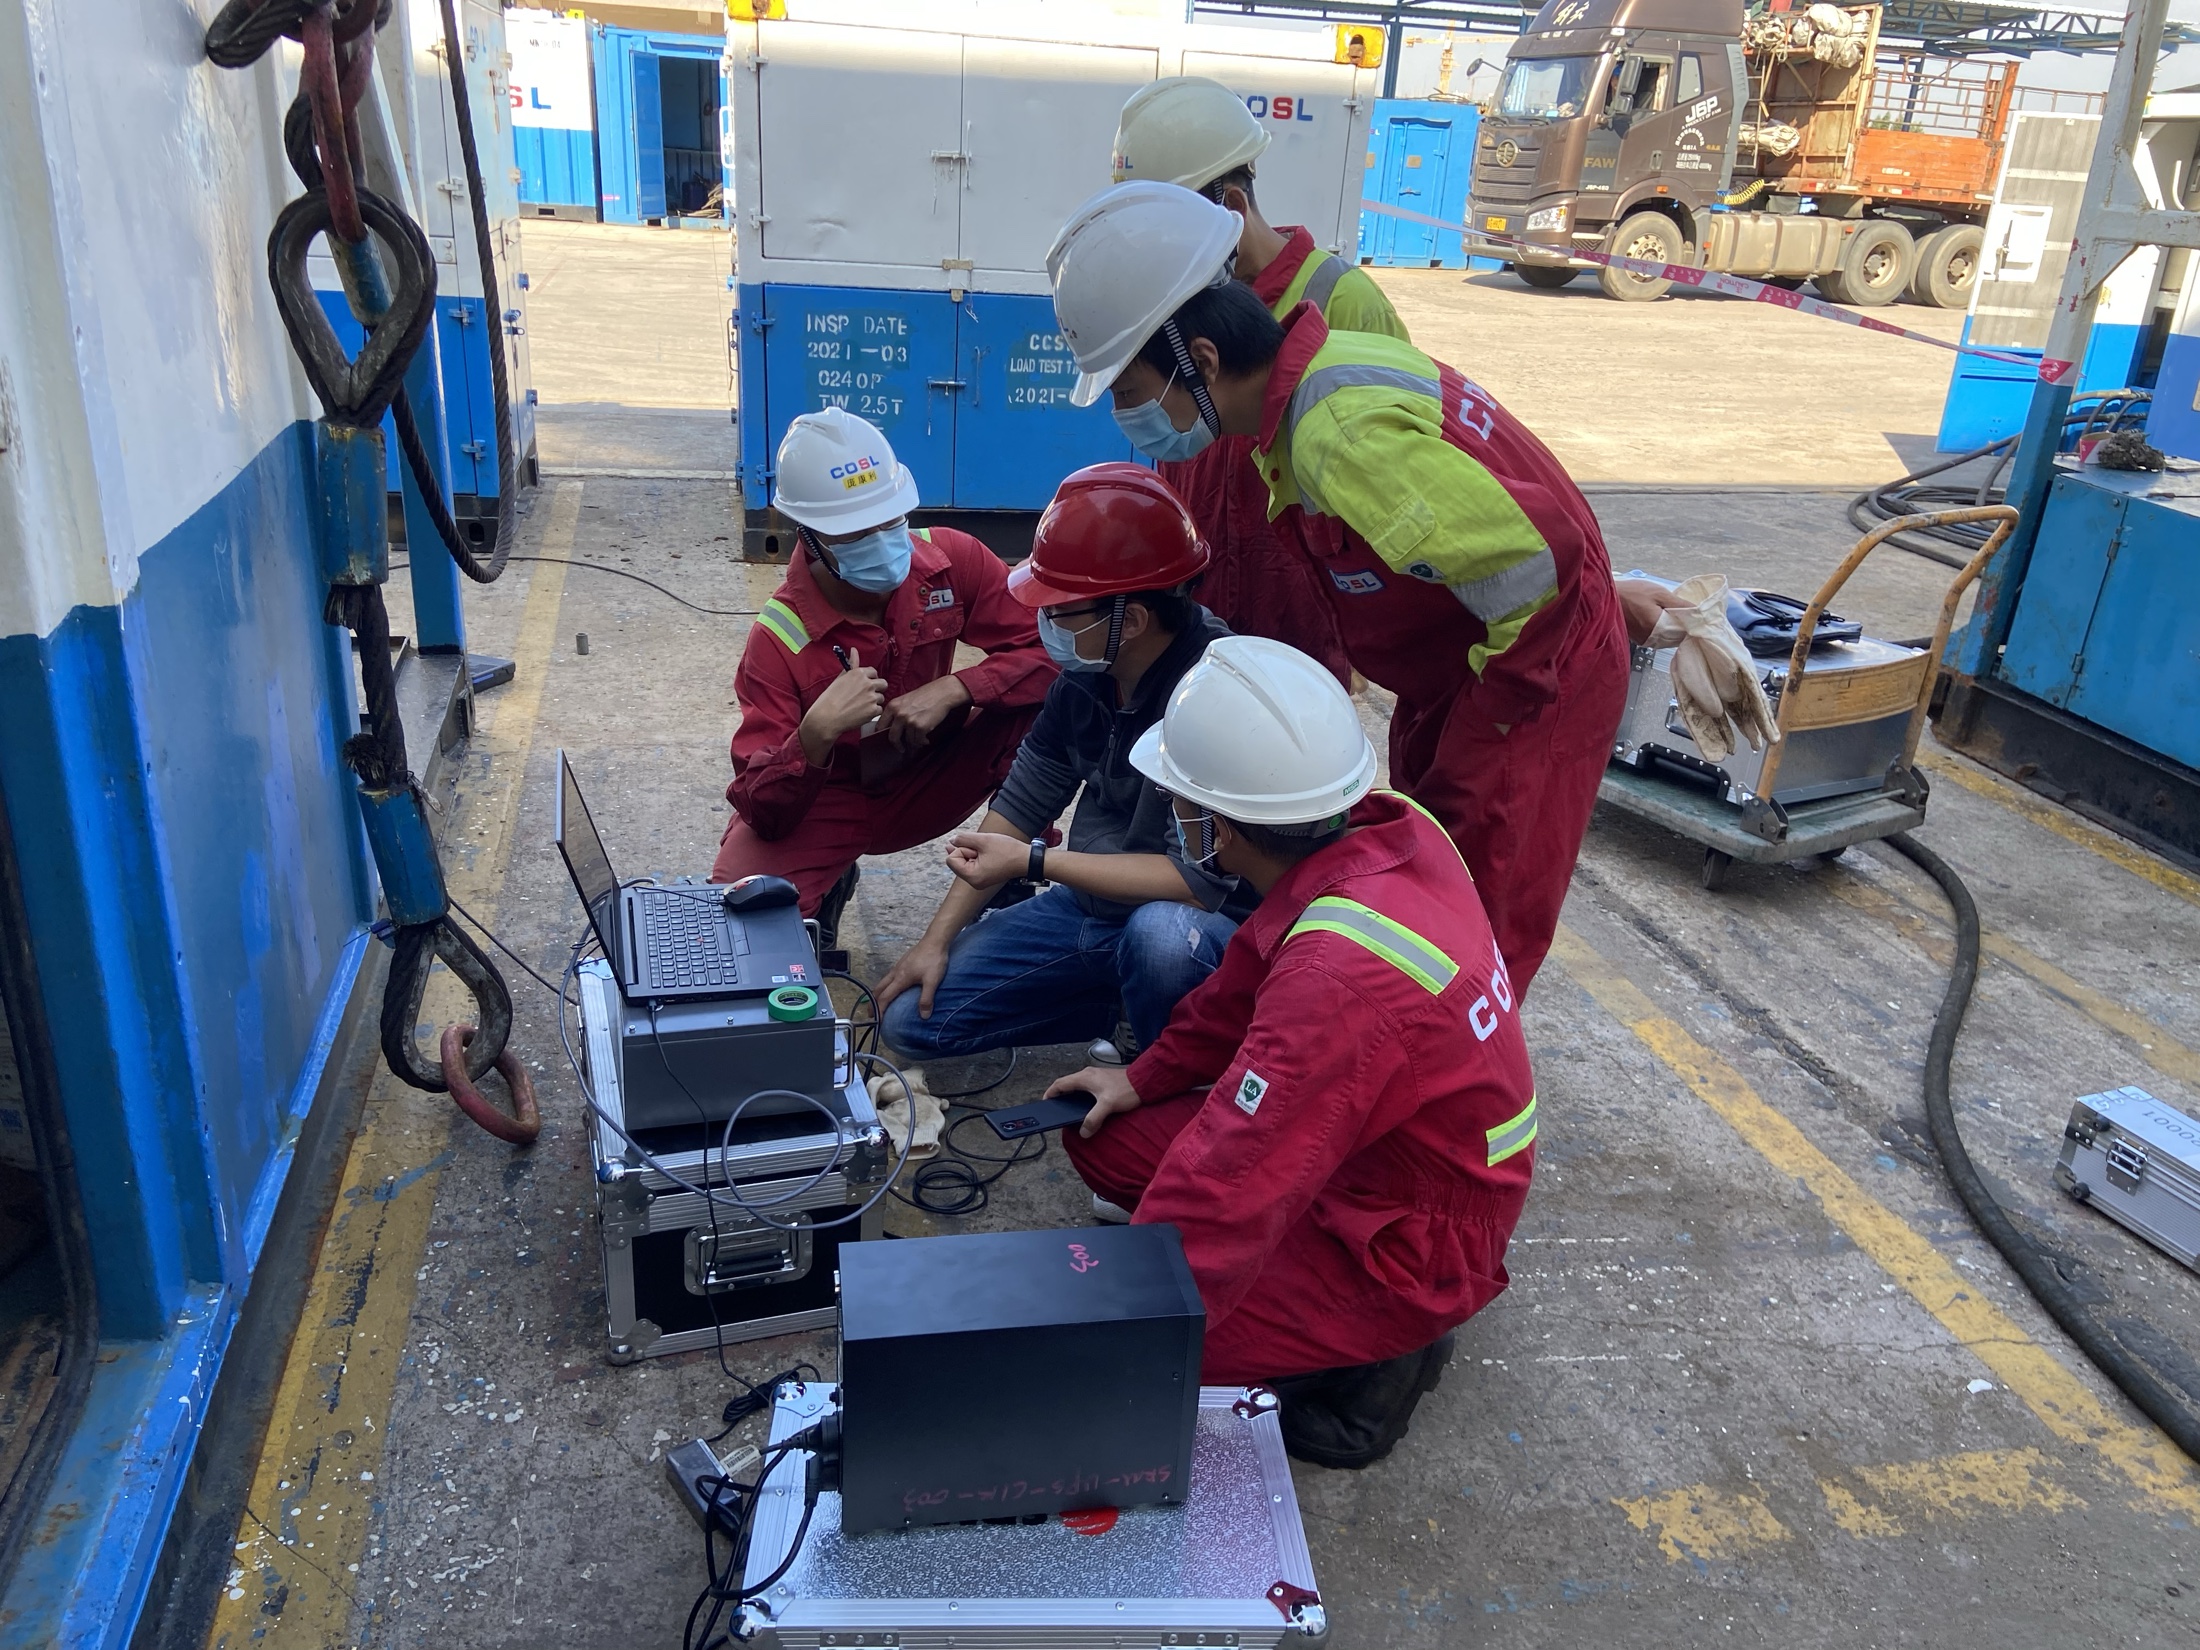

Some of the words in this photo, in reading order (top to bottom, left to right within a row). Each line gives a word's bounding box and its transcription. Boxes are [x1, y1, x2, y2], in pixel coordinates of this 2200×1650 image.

[1238, 95, 1313, 121] OSL
[1685, 95, 1718, 123] J6P
[1583, 157, 1617, 169] FAW
[1719, 277, 1750, 289] CAUTION
[807, 314, 849, 335] INSP
[864, 317, 907, 335] DATE
[1029, 333, 1071, 352] CCS
[1010, 357, 1035, 373] LOAD
[1039, 359, 1063, 374] TEST
[830, 455, 880, 480] COSL
[1244, 1081, 1257, 1097] LA
